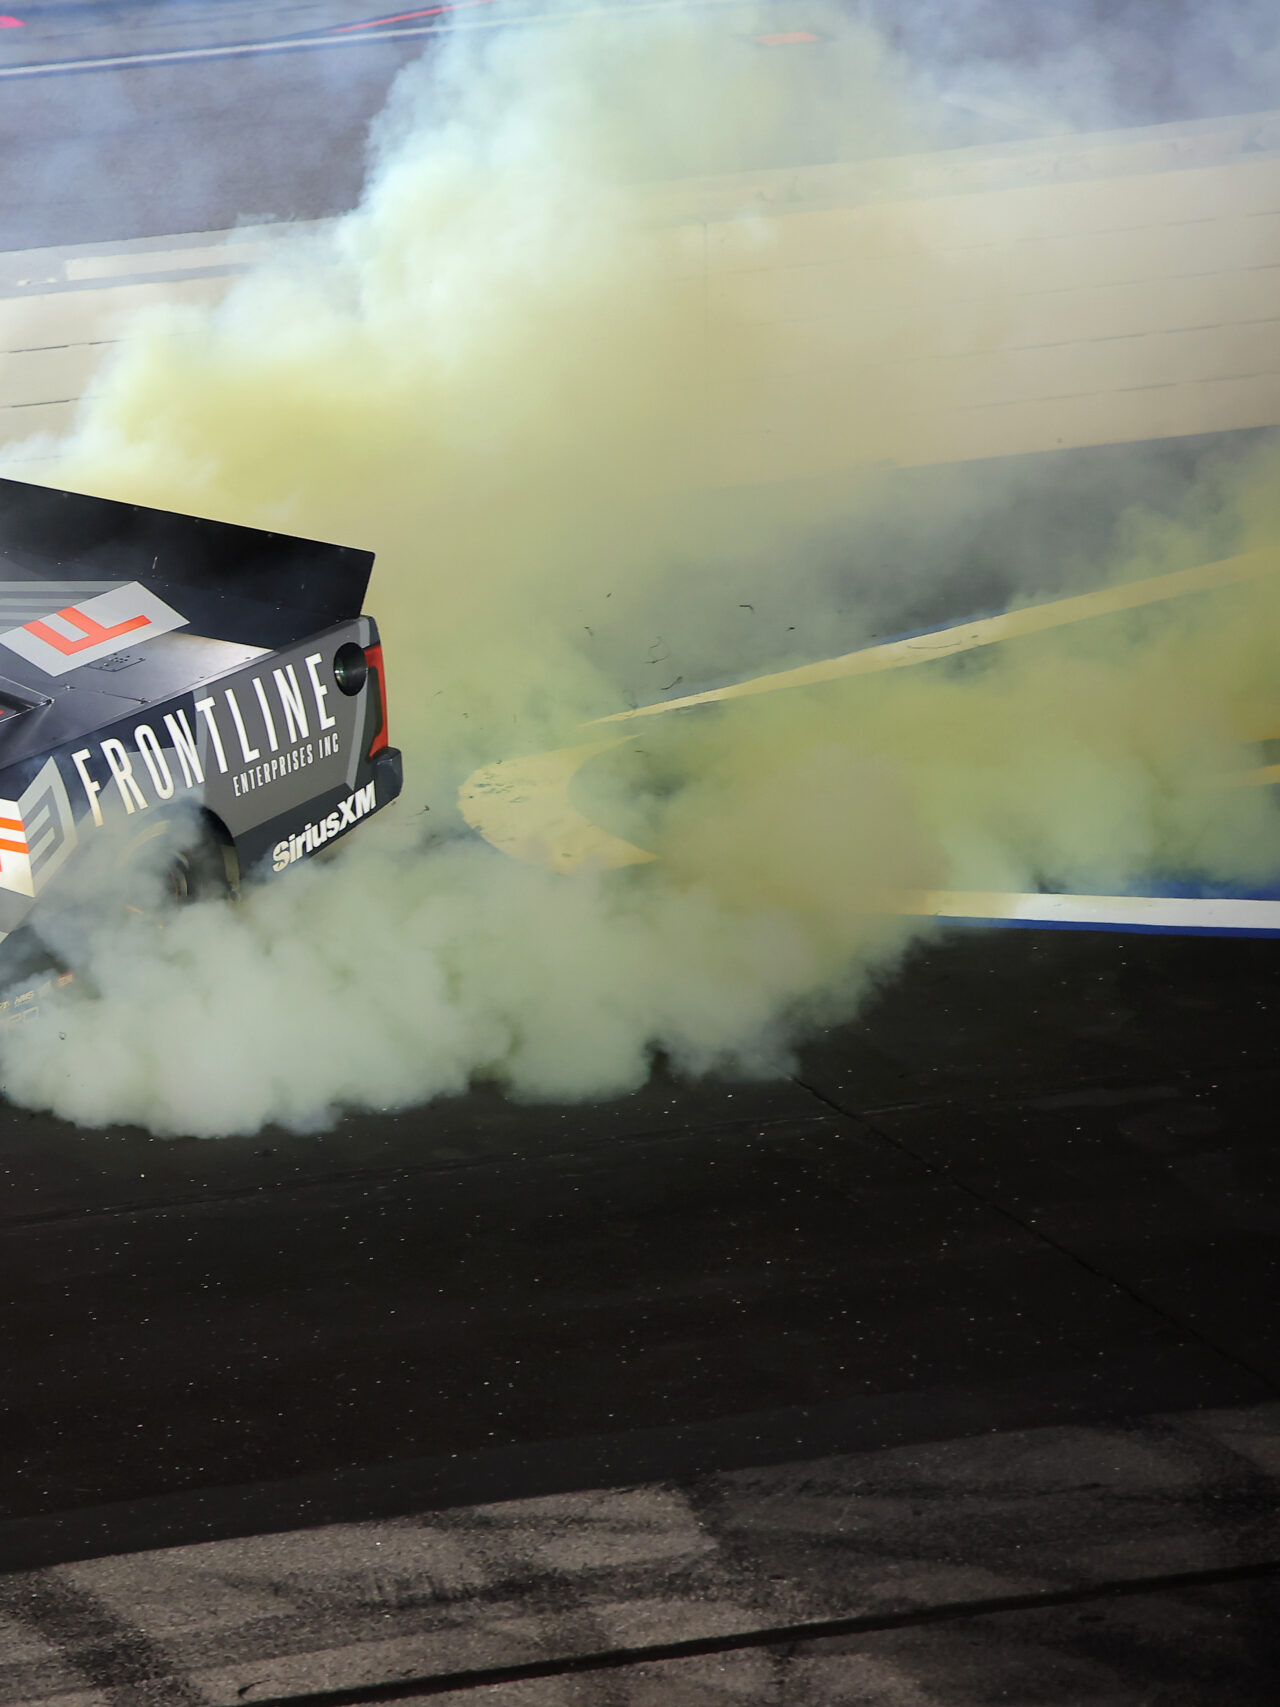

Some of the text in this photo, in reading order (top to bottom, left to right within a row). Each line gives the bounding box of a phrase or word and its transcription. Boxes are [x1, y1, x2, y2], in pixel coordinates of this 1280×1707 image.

[72, 653, 336, 828] FRONTLINE
[232, 733, 339, 798] ENTERPRISES INC
[272, 781, 377, 873] SiriusXM
